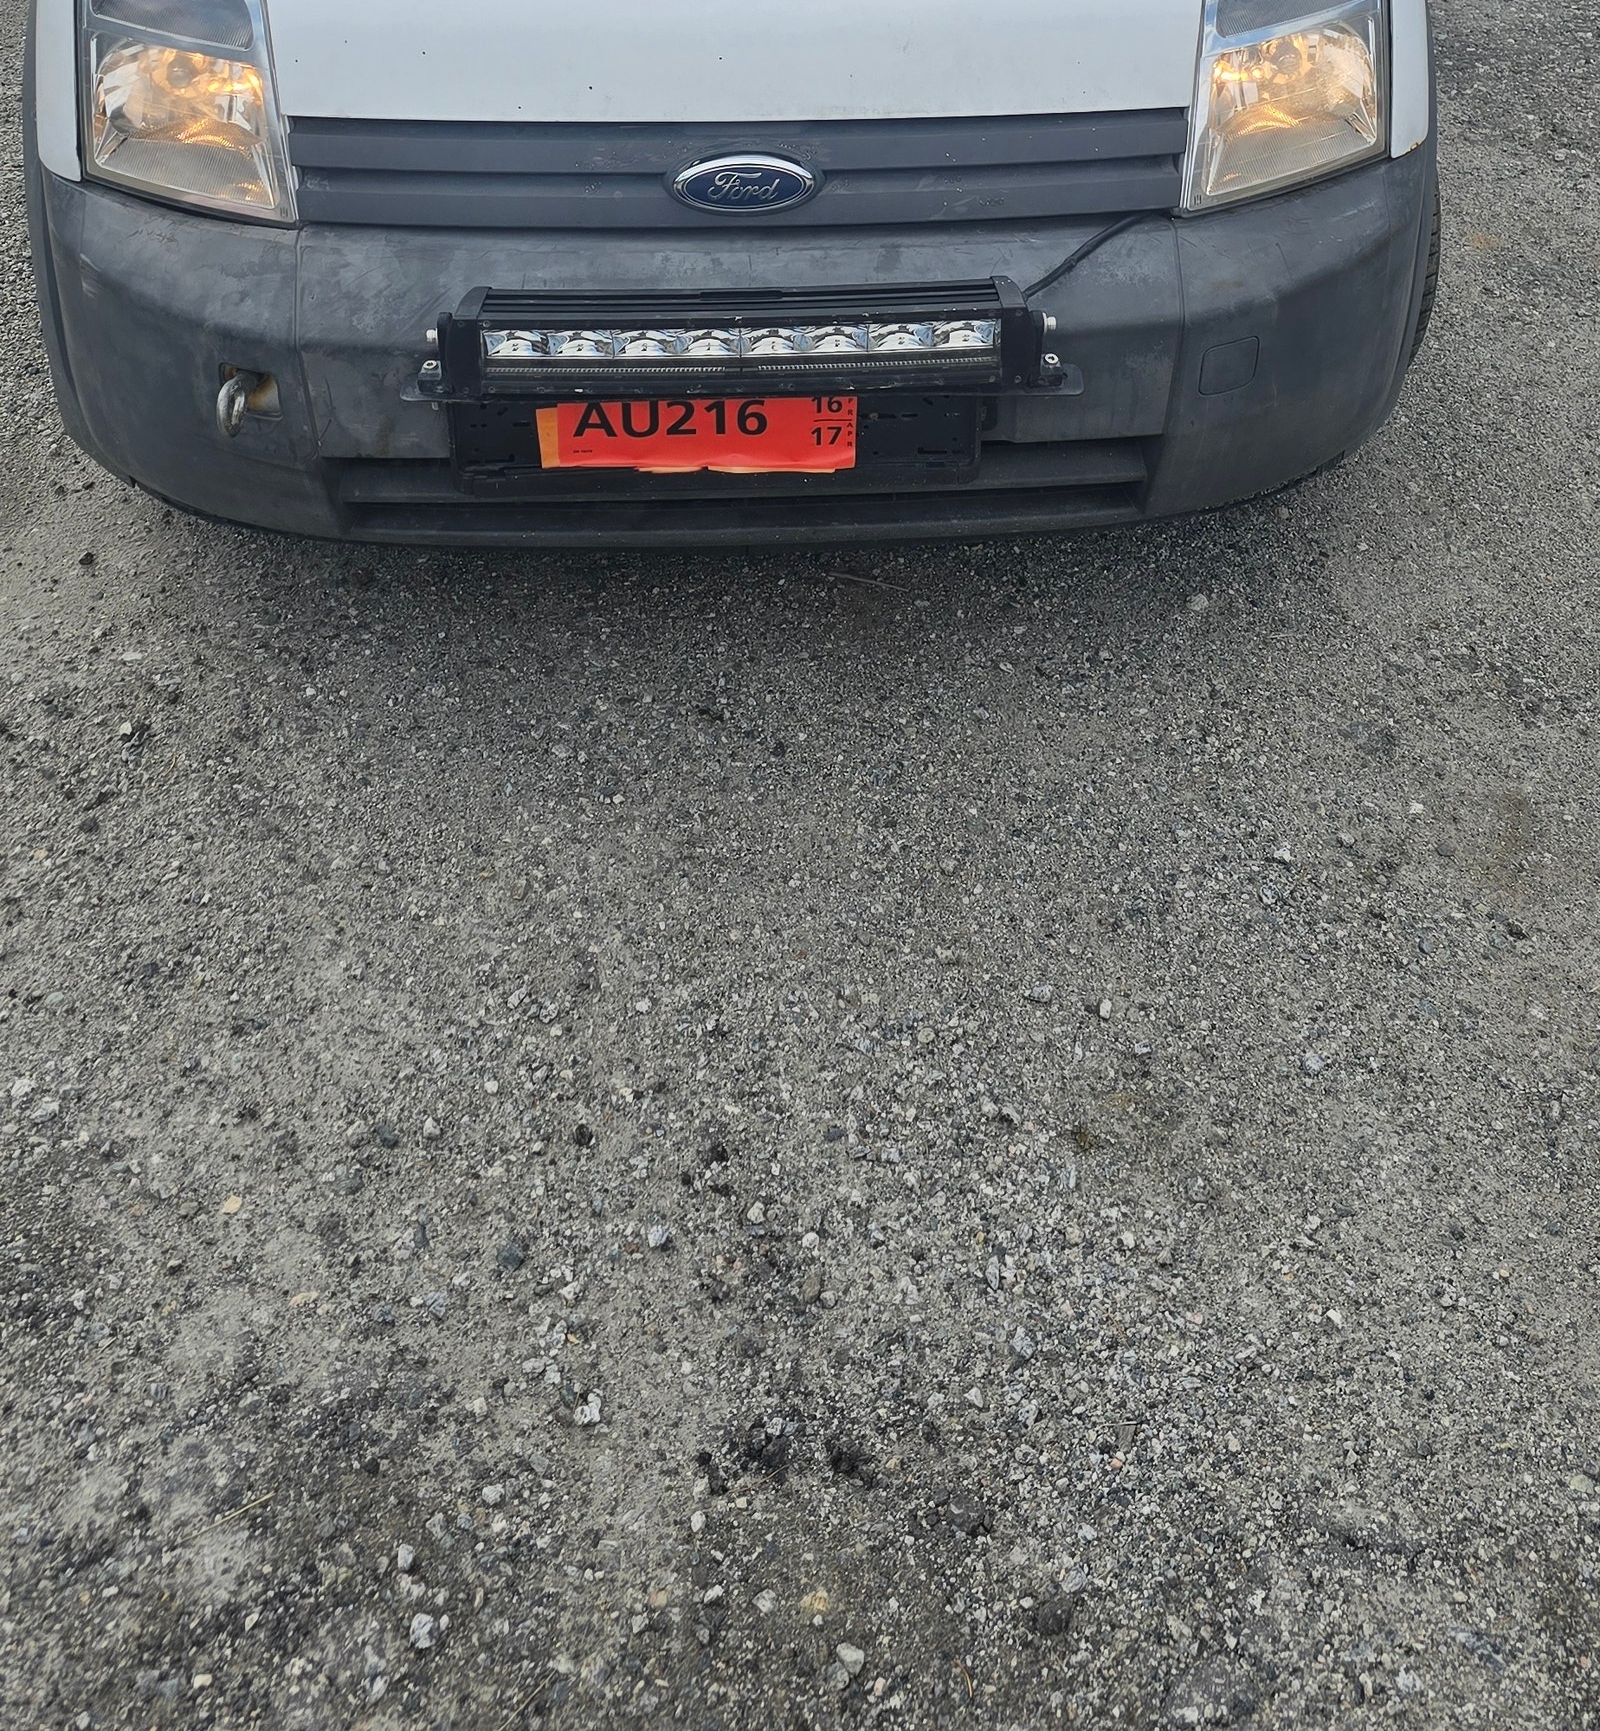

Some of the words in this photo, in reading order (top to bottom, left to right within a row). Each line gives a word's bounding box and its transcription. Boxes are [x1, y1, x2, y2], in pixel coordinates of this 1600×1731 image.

[707, 171, 781, 200] Ford
[811, 397, 843, 414] 16
[573, 400, 767, 438] AU216
[811, 426, 842, 446] 17
